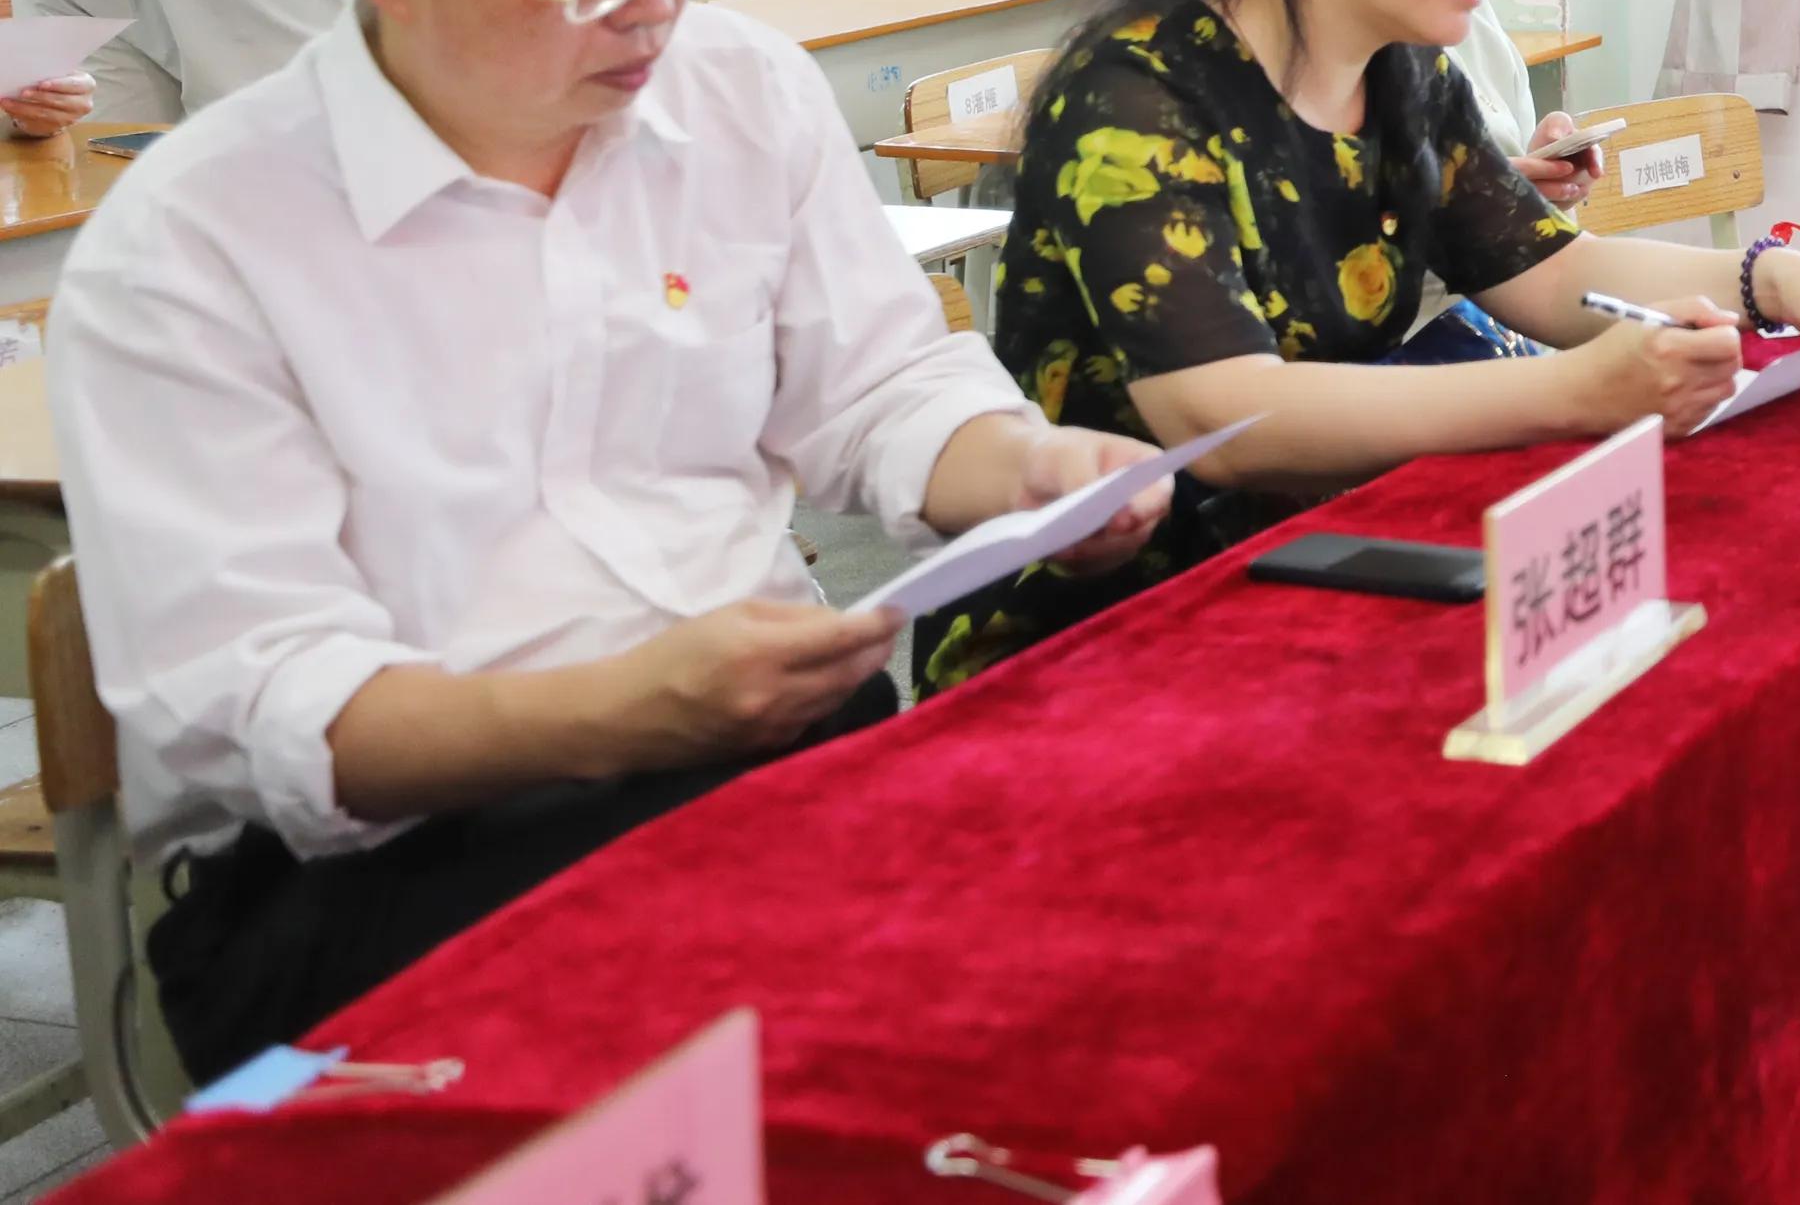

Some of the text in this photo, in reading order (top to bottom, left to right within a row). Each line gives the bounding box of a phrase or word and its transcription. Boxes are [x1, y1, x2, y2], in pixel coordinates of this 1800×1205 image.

[1635, 155, 1690, 185] 7刘艳梅
[1512, 489, 1645, 668] 张超群
